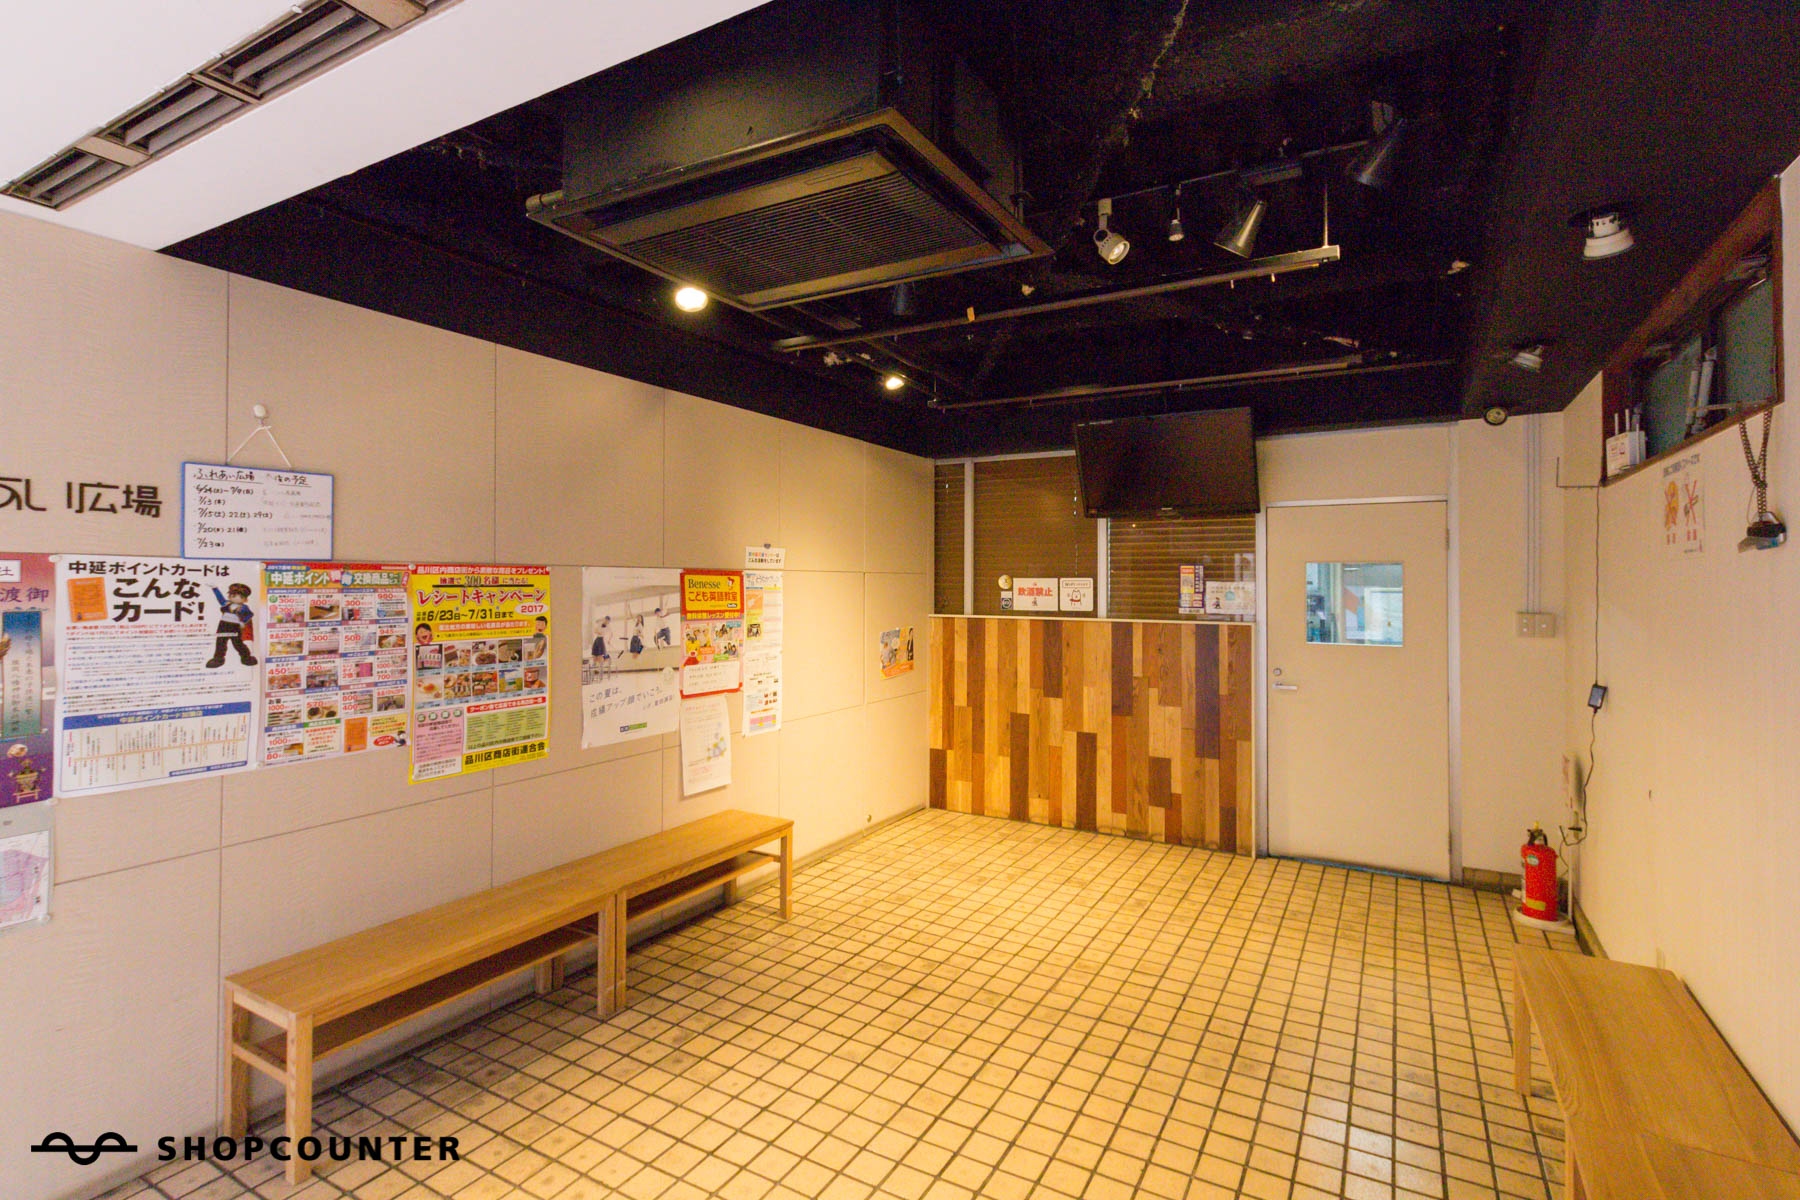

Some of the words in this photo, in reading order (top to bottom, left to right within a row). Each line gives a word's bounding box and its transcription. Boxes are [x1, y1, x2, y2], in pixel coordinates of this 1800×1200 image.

[68, 561, 230, 577] 中延ポイントカードは
[113, 578, 200, 599] こんな
[687, 578, 721, 589] Benesse
[416, 589, 546, 605] レシートキャンペーン
[688, 591, 738, 602] こども英語教室
[113, 601, 205, 622] カード!
[520, 605, 544, 613] 2017
[465, 742, 545, 765] 品川区商店街連合会
